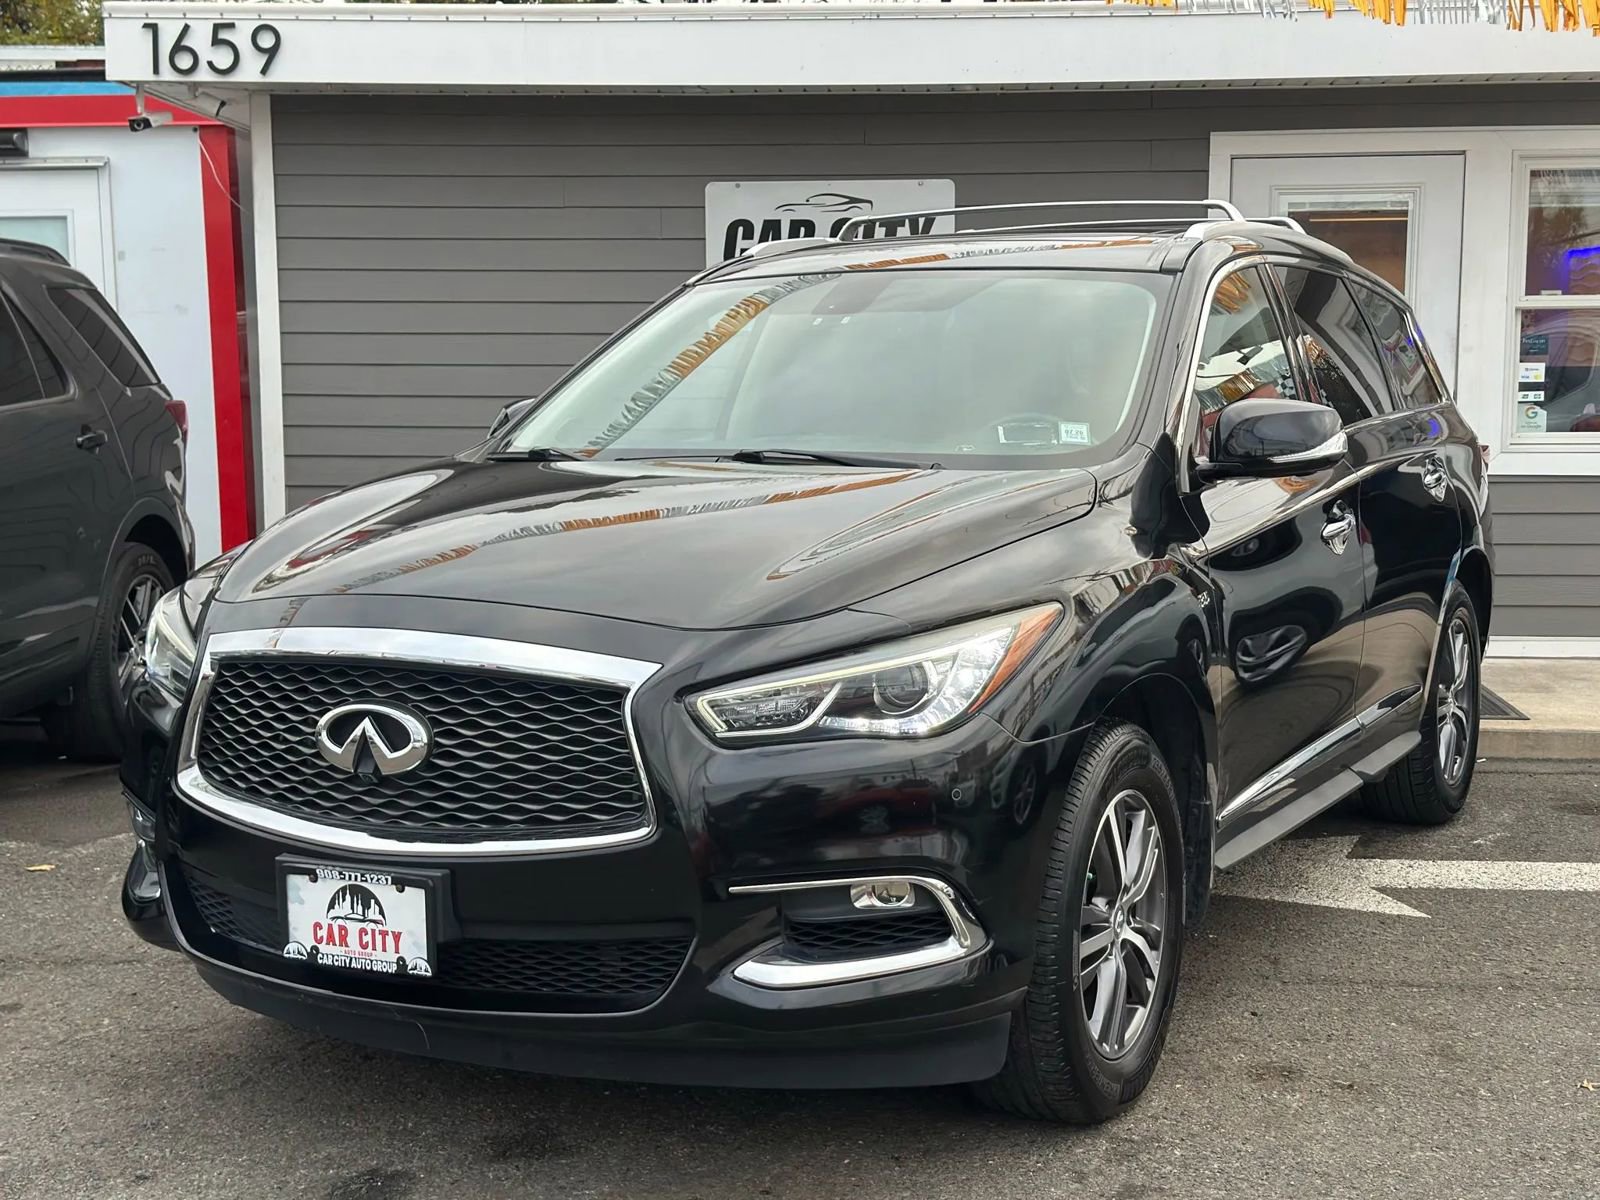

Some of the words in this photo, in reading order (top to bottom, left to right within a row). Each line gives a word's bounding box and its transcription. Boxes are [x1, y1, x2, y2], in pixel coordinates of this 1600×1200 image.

[142, 22, 281, 76] 1659
[312, 921, 350, 948] CAR
[358, 927, 403, 954] CITY
[317, 953, 333, 965] CAR
[333, 955, 351, 968] CITY
[351, 957, 371, 970] AUTO
[372, 960, 397, 974] GROUP
